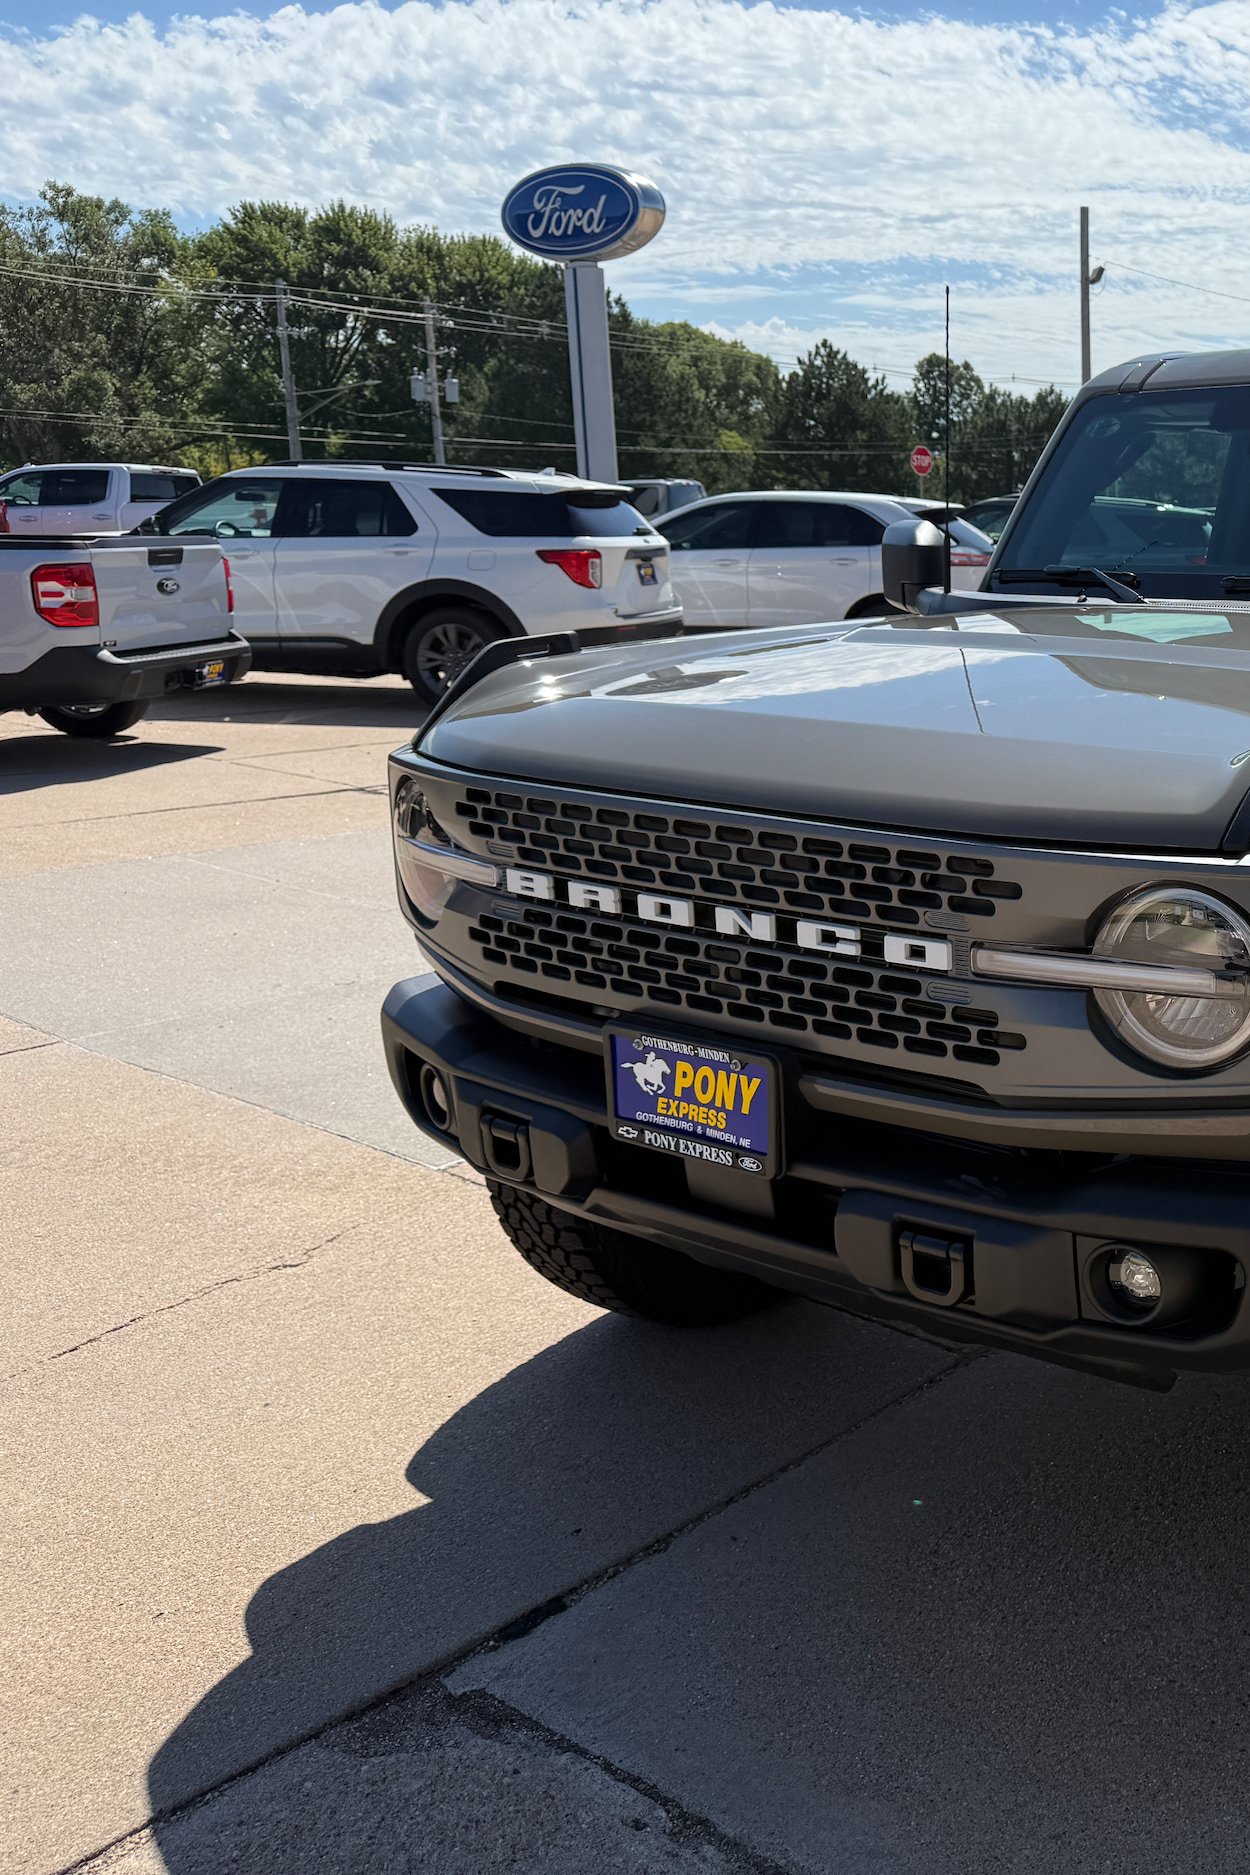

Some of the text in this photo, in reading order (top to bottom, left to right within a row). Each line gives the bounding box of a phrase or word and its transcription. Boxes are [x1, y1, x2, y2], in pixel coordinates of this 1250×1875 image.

[527, 184, 607, 239] Ford
[912, 454, 931, 467] STOP
[505, 867, 954, 971] BRONCO
[674, 1060, 762, 1115] PONY
[635, 1111, 752, 1149] GOTHENBURG & MINDEN, NE
[657, 1097, 727, 1130] EXPRESS
[644, 1130, 733, 1166] PONY EXPRESS
